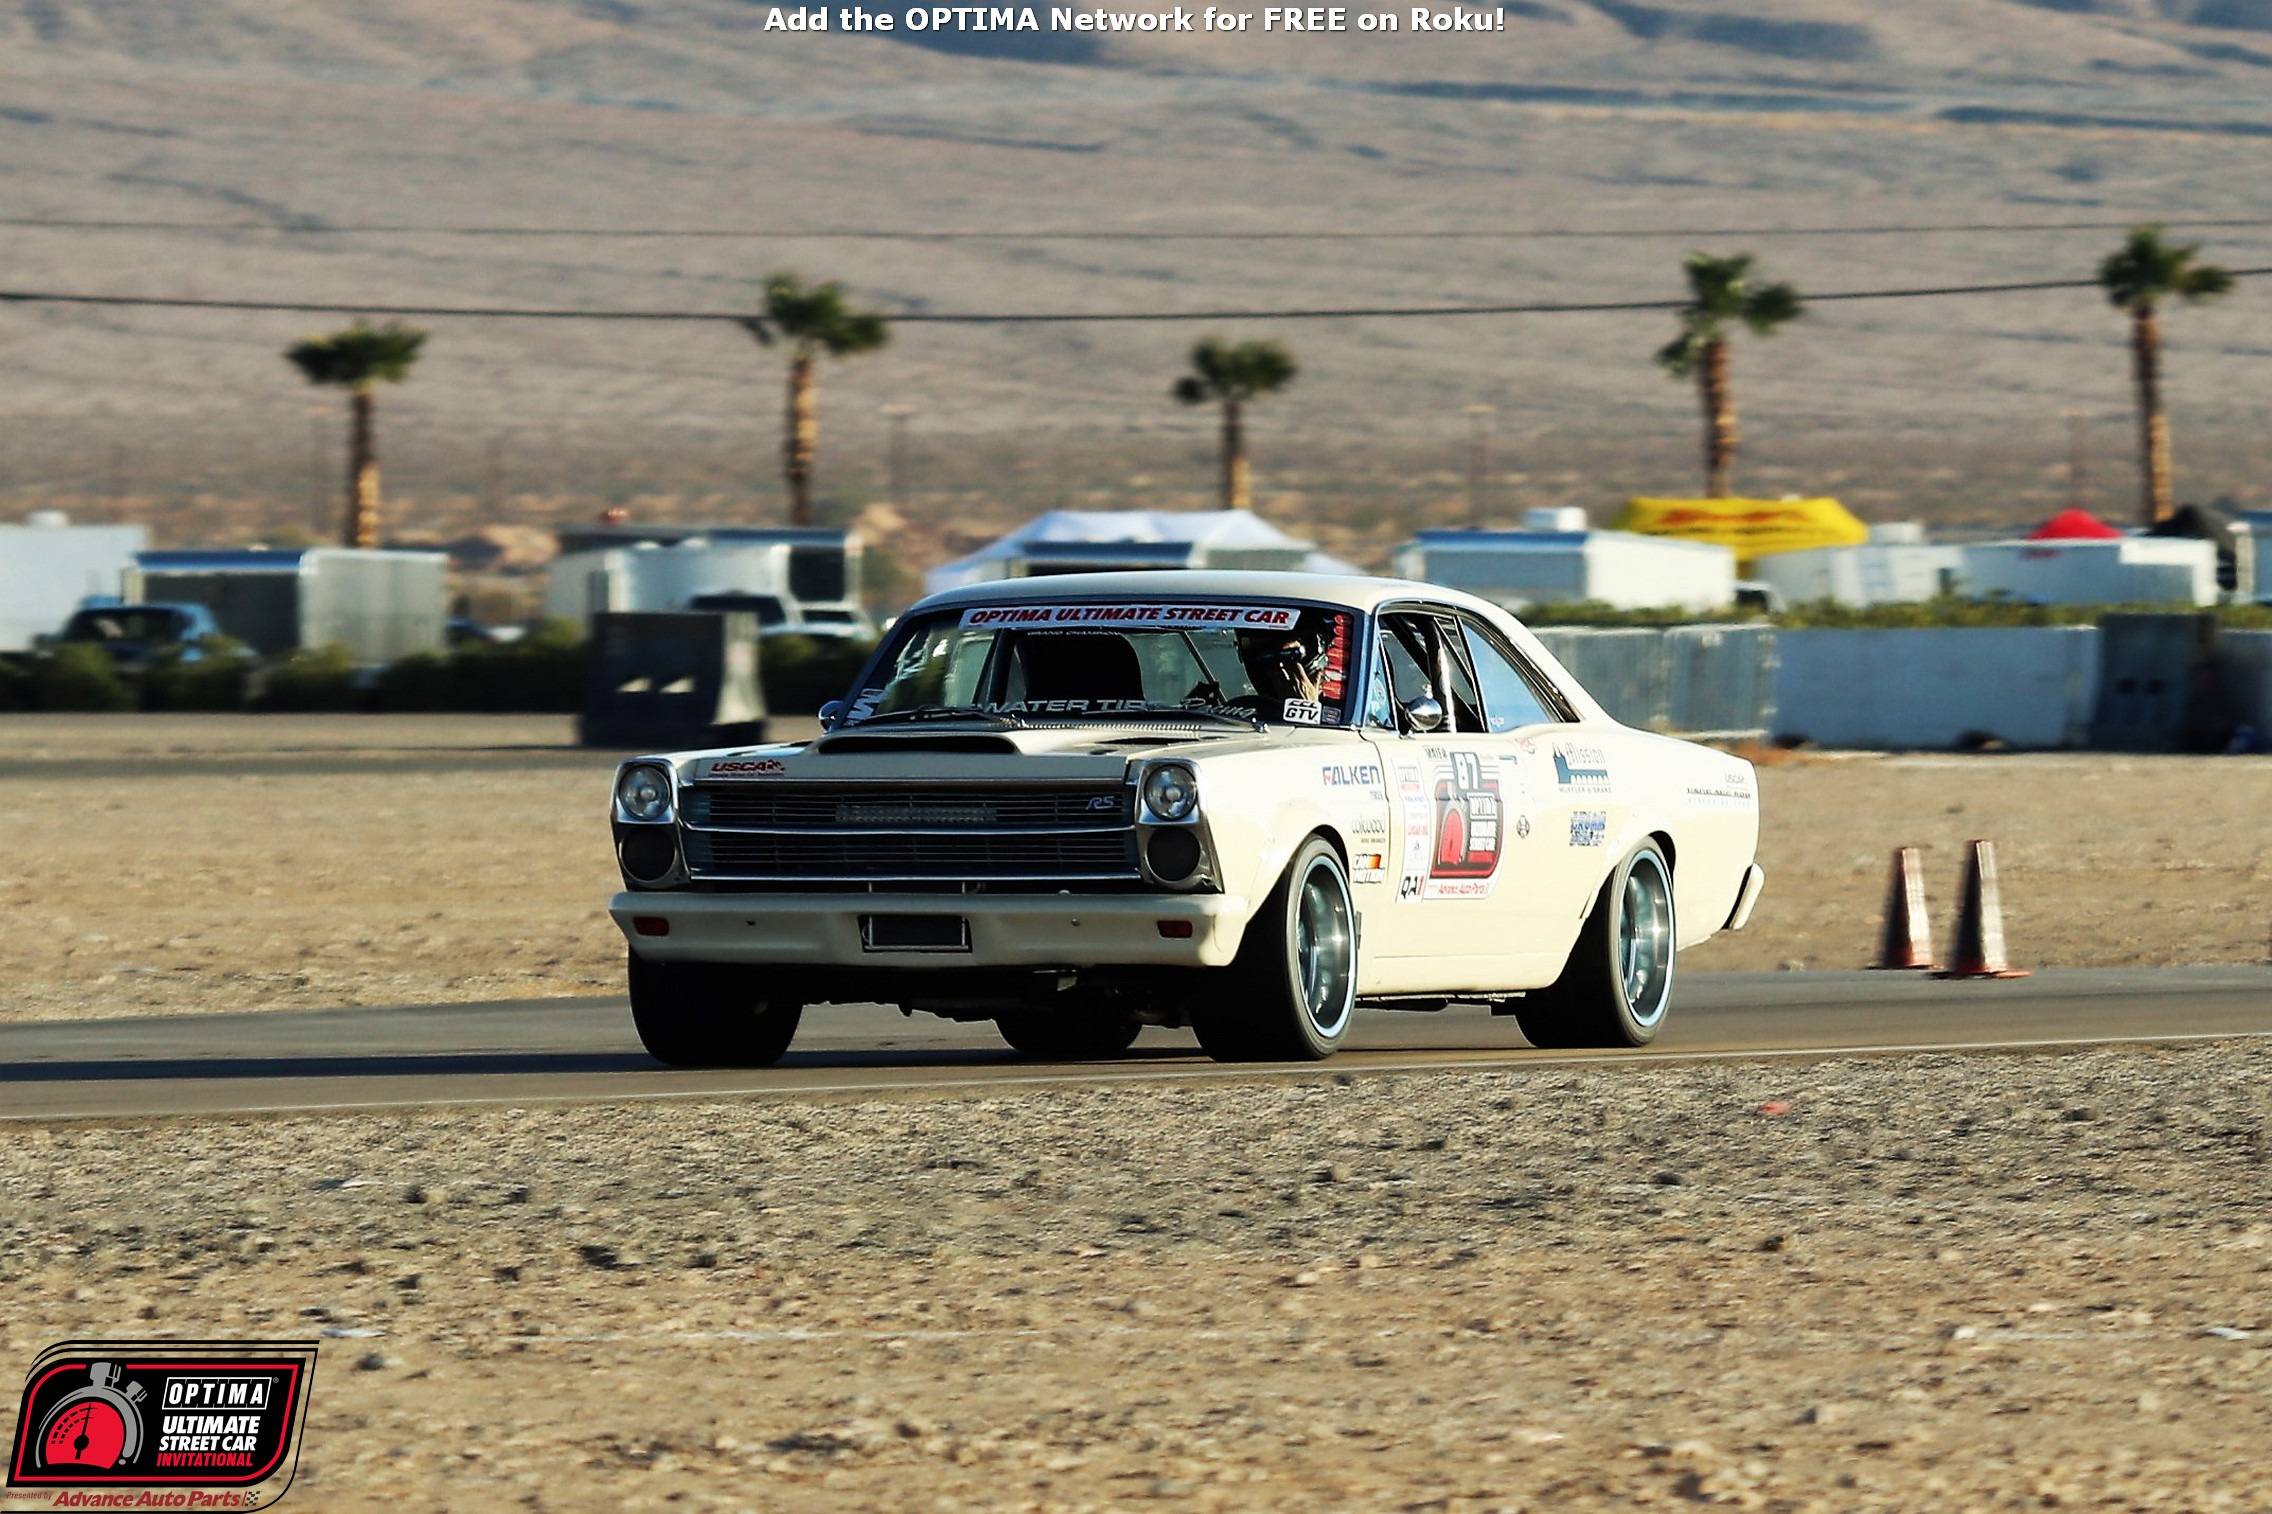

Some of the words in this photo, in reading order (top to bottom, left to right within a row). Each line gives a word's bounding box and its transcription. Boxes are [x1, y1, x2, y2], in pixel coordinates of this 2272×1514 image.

[969, 609, 1052, 624] OPTIMA
[1055, 607, 1162, 622] ULTIMATE
[1163, 607, 1244, 623] STREET
[1244, 609, 1290, 625] CAR
[1285, 707, 1319, 720] GTV
[1322, 765, 1381, 786] FALKEN
